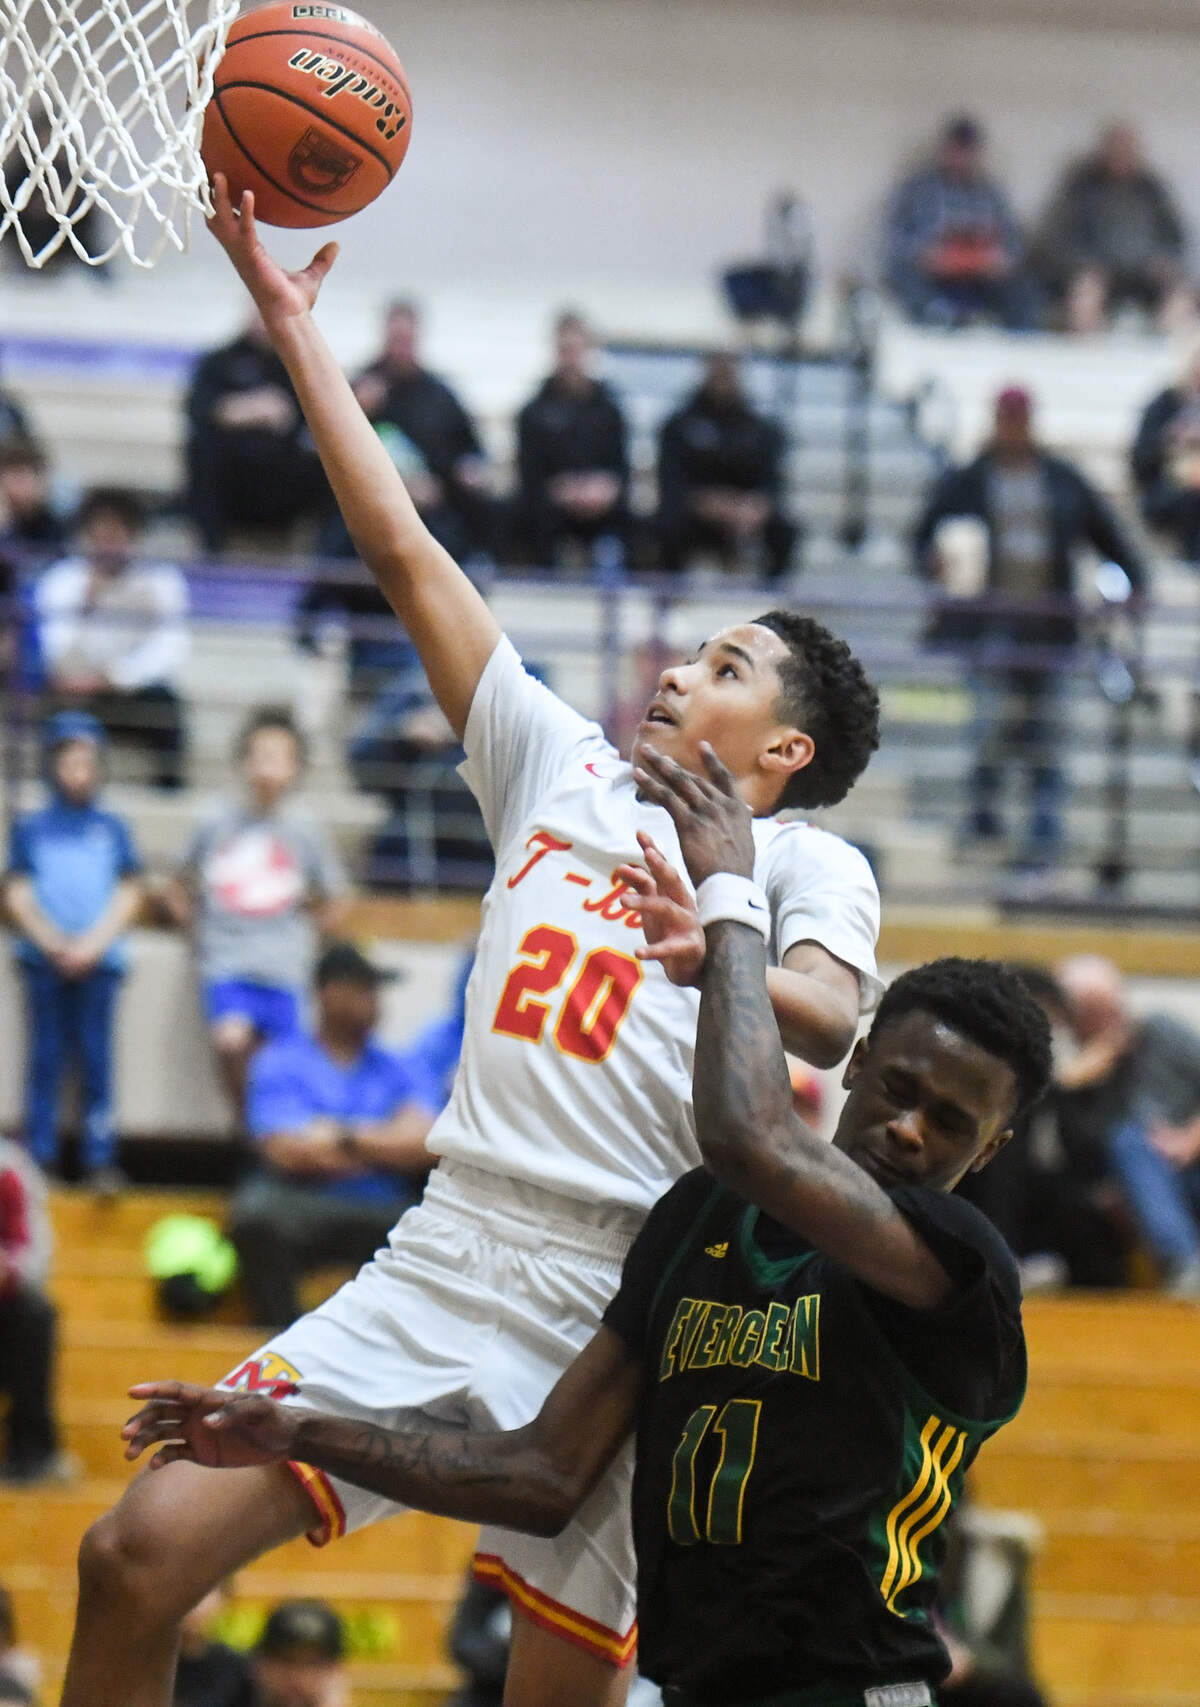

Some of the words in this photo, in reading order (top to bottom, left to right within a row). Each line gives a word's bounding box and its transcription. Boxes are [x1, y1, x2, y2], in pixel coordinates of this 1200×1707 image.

[287, 47, 407, 141] Baden
[491, 922, 644, 1065] 20
[667, 1399, 762, 1546] 11
